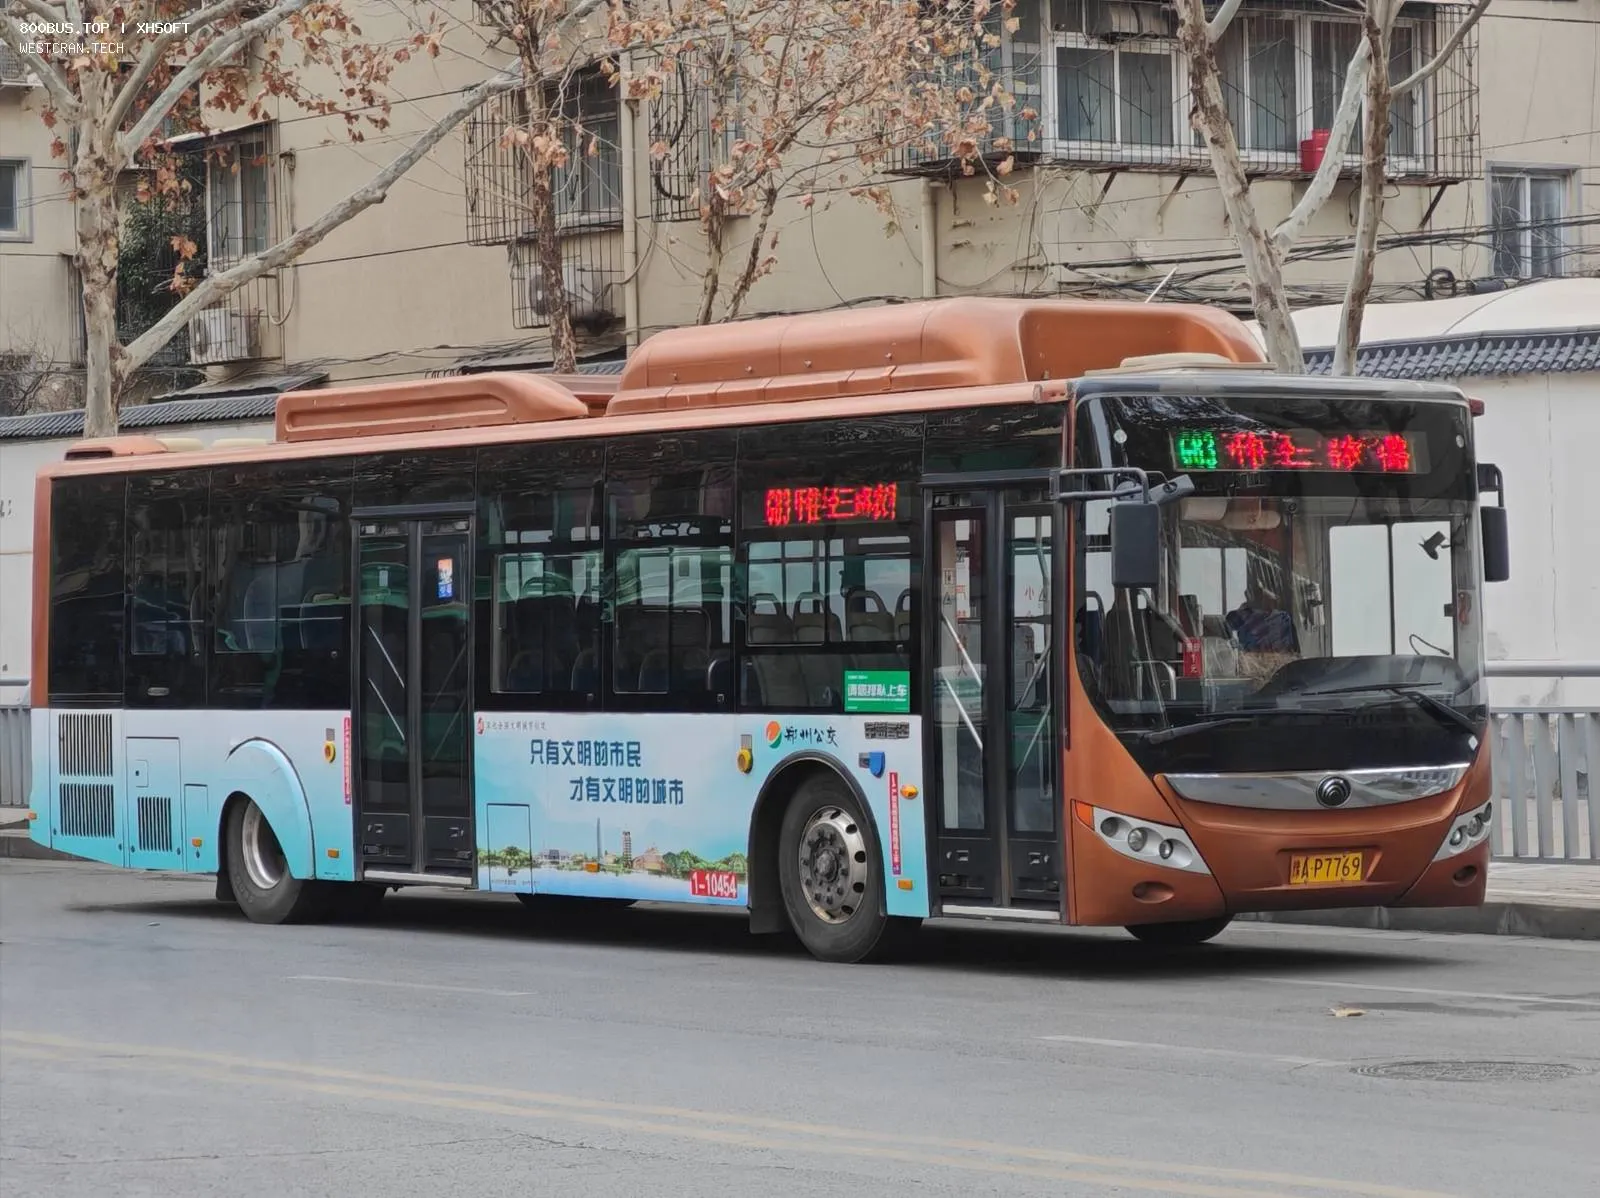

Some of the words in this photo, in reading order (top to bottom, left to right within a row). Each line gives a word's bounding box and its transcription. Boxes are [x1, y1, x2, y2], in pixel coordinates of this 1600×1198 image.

[783, 725, 839, 748] 郑州公交
[530, 739, 641, 767] 只有文明的市民
[569, 776, 684, 805] 才有文明的城市
[692, 871, 737, 898] 1-10454
